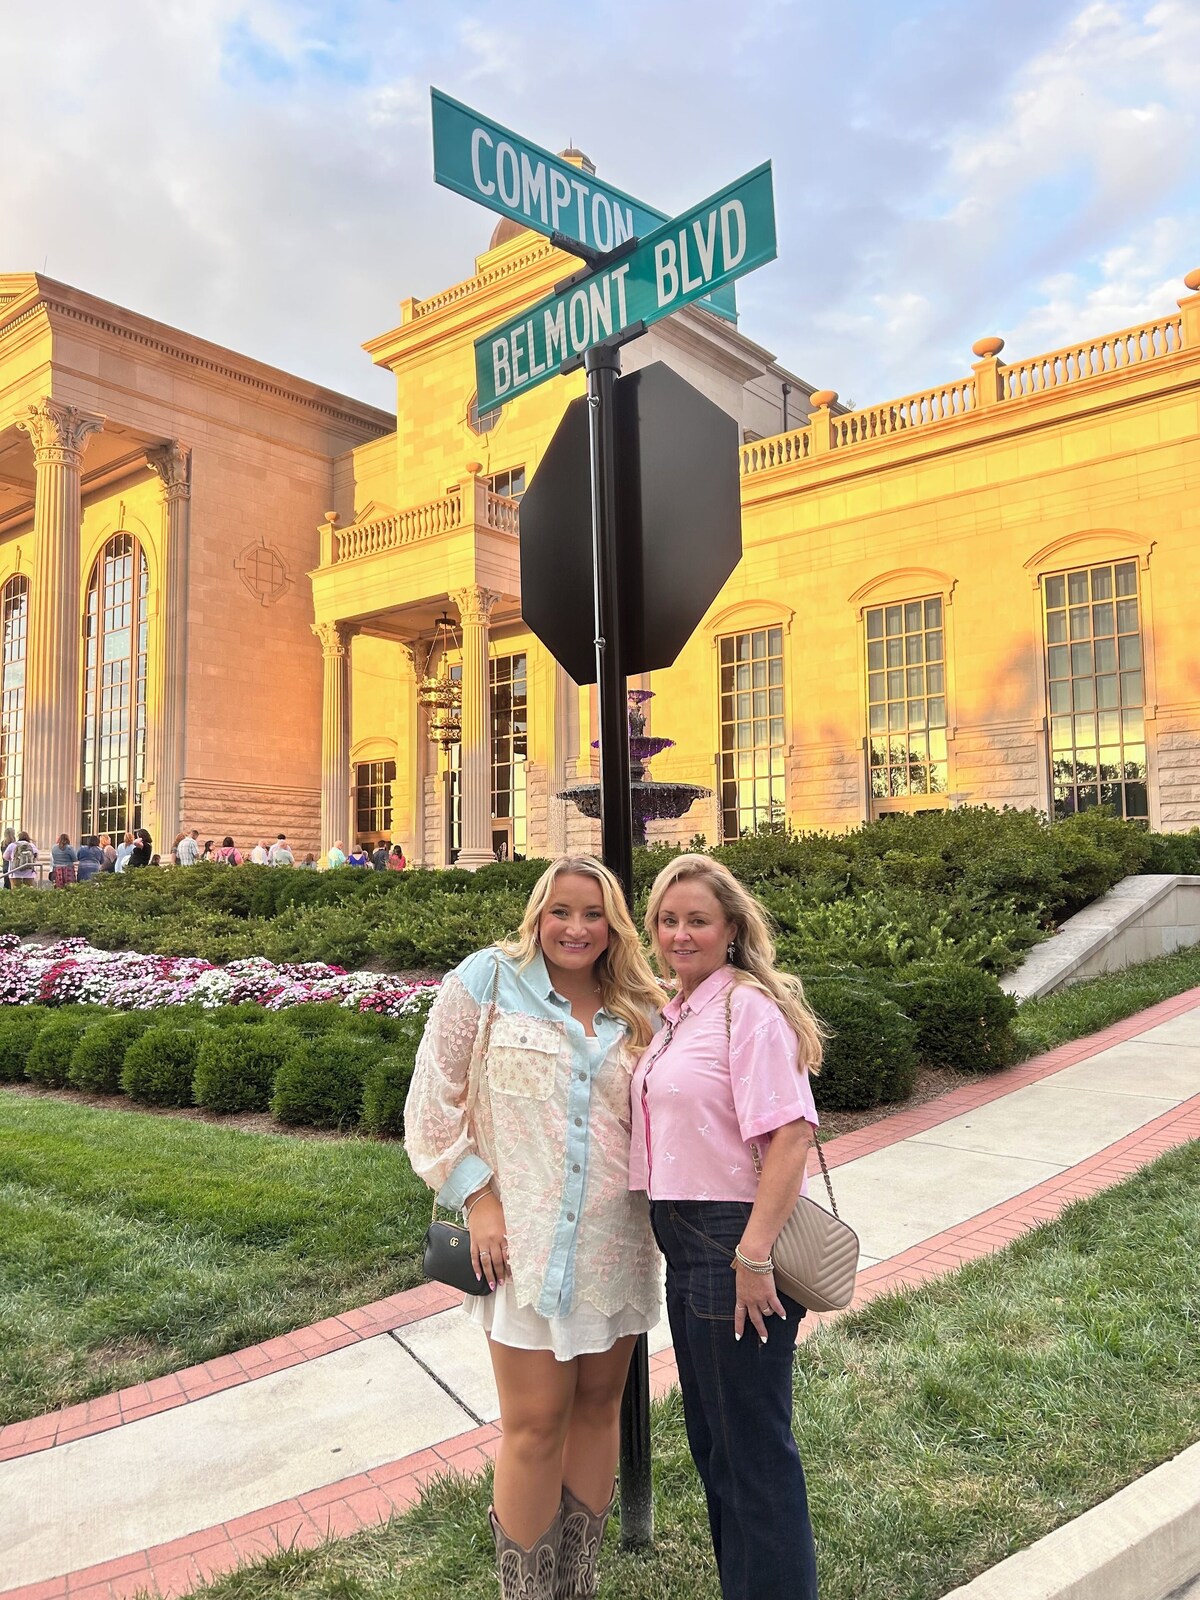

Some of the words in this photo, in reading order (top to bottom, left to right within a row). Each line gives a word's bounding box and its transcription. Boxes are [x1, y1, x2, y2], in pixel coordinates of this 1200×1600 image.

[471, 128, 633, 252] COMPTON
[492, 263, 630, 397] BELMONT
[654, 199, 747, 308] BLVD
